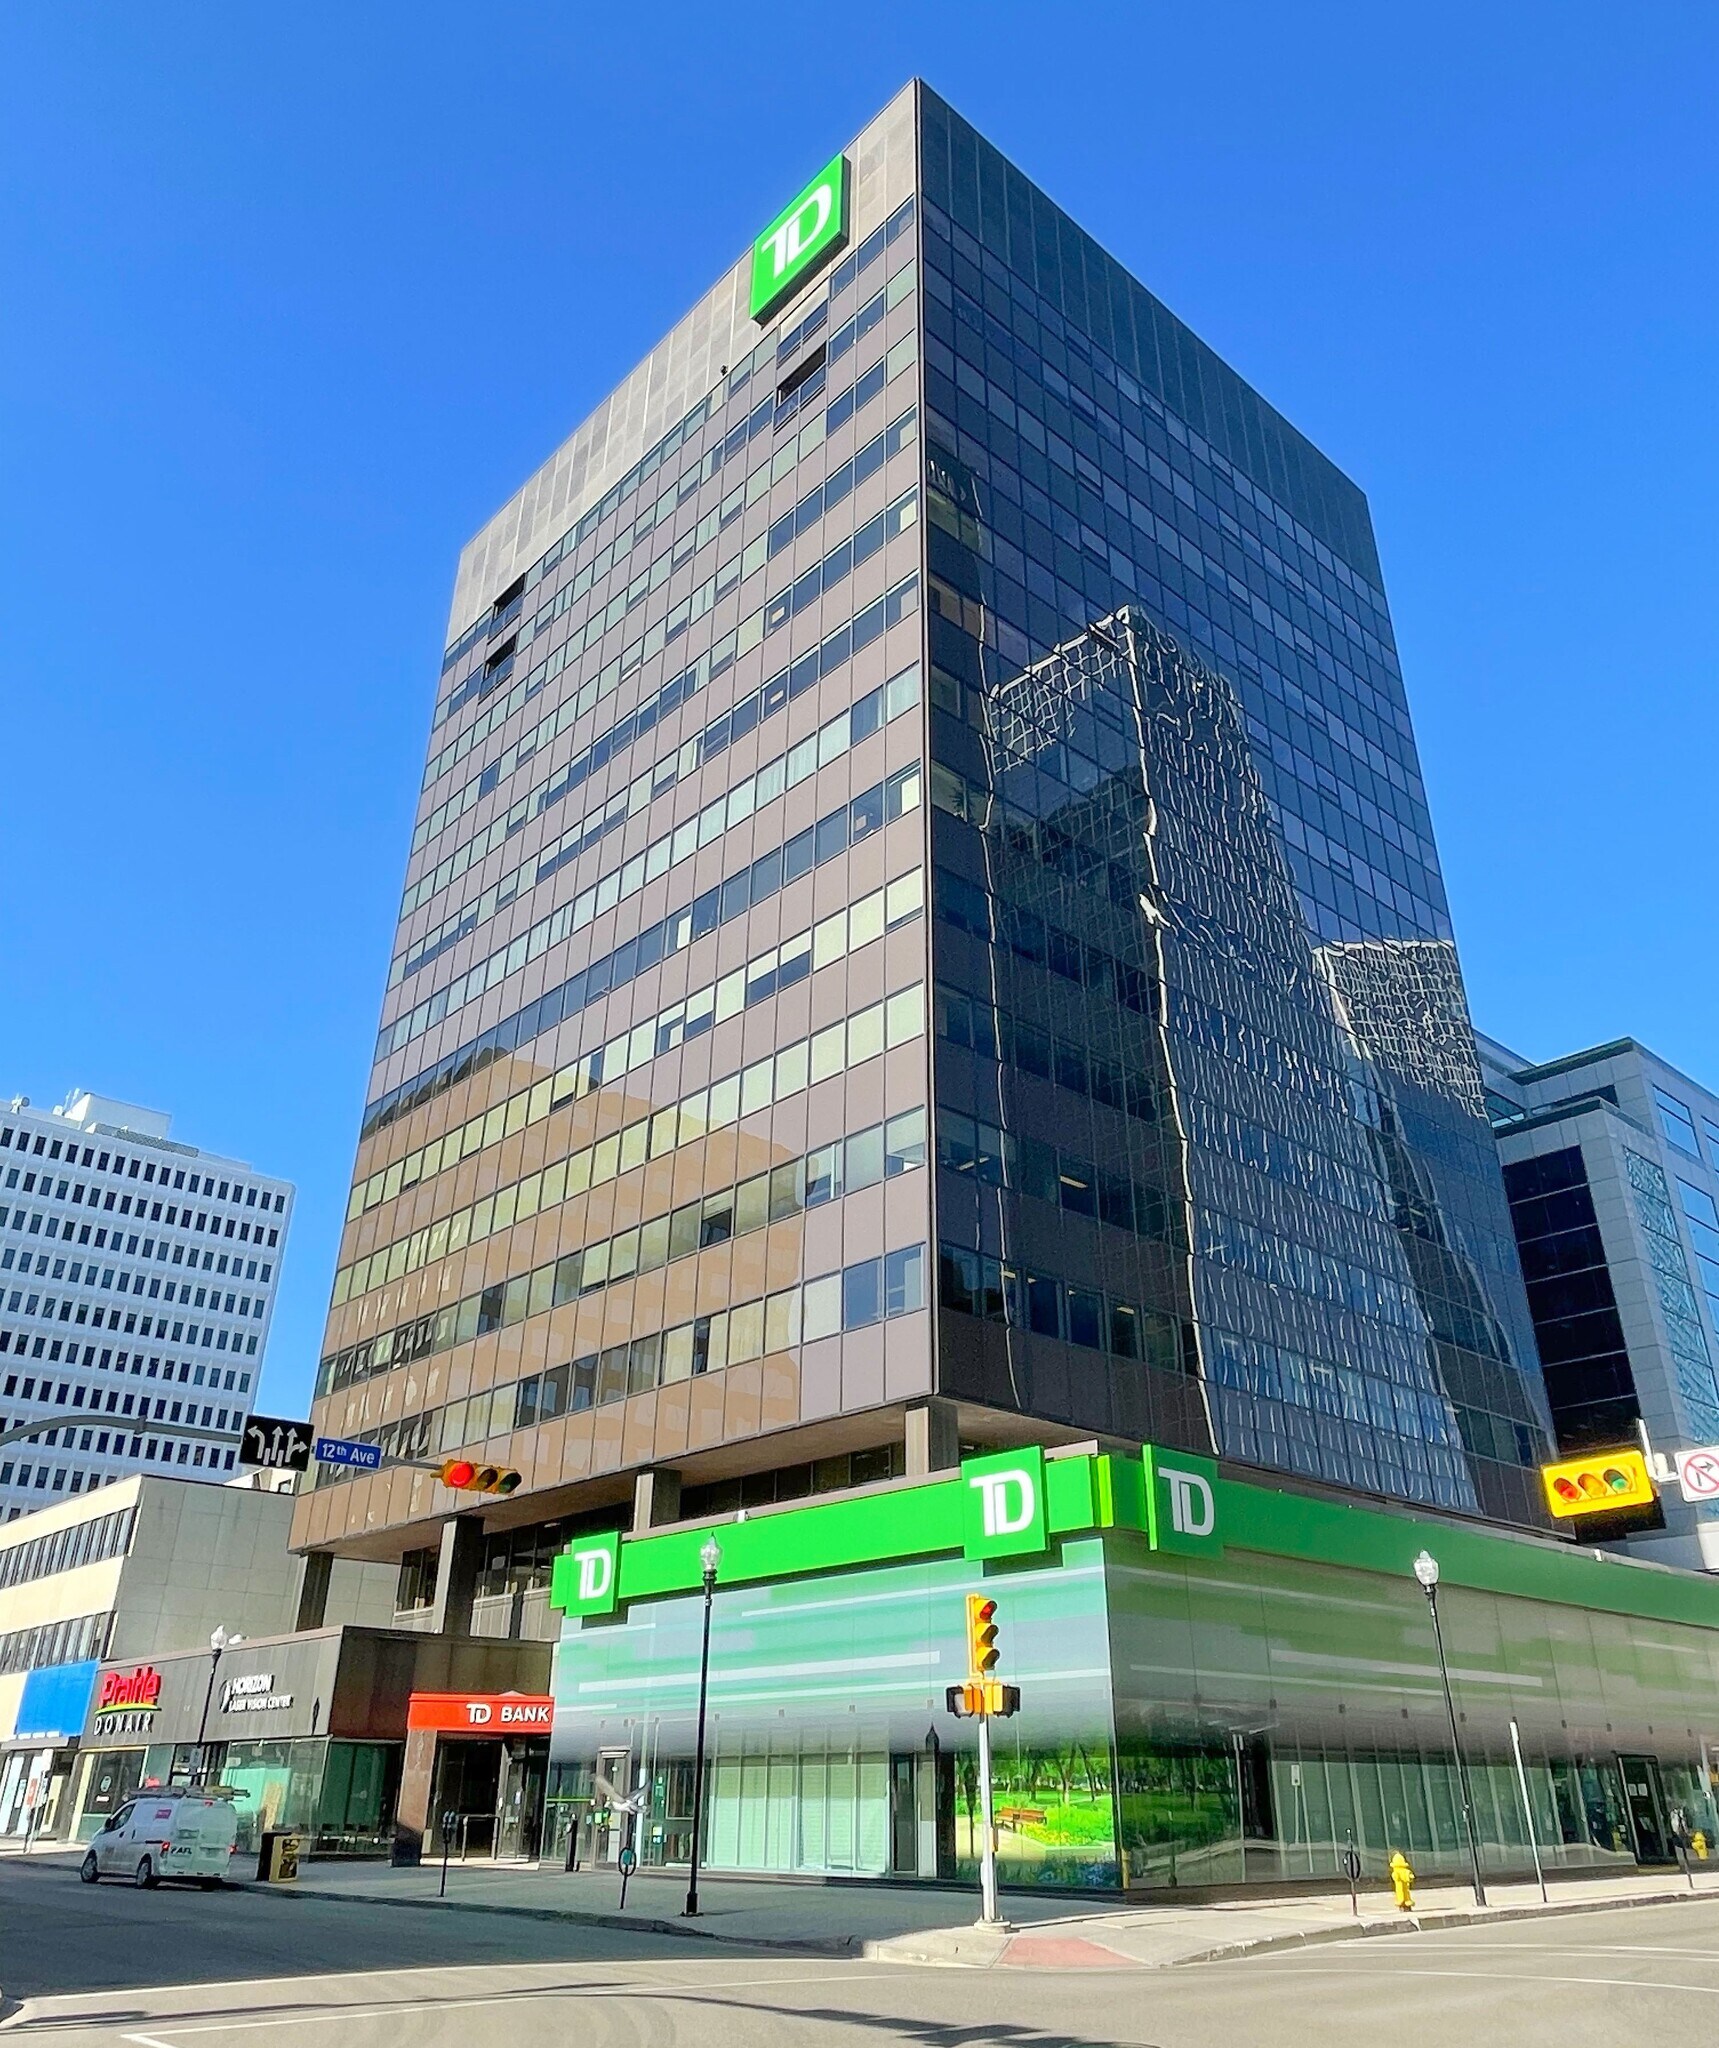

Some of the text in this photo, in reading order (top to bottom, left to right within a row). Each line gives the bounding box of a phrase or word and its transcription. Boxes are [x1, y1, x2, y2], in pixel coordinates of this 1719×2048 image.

[761, 184, 832, 280] TD
[322, 1443, 375, 1464] 12th Ave
[969, 1469, 1035, 1537] TD
[1158, 1467, 1215, 1537] TD
[574, 1548, 612, 1600] TD
[98, 1666, 161, 1709] Prairie
[231, 1673, 274, 1695] HORIZON
[94, 1712, 153, 1735] DONAIR
[466, 1703, 550, 1724] TD BANK
